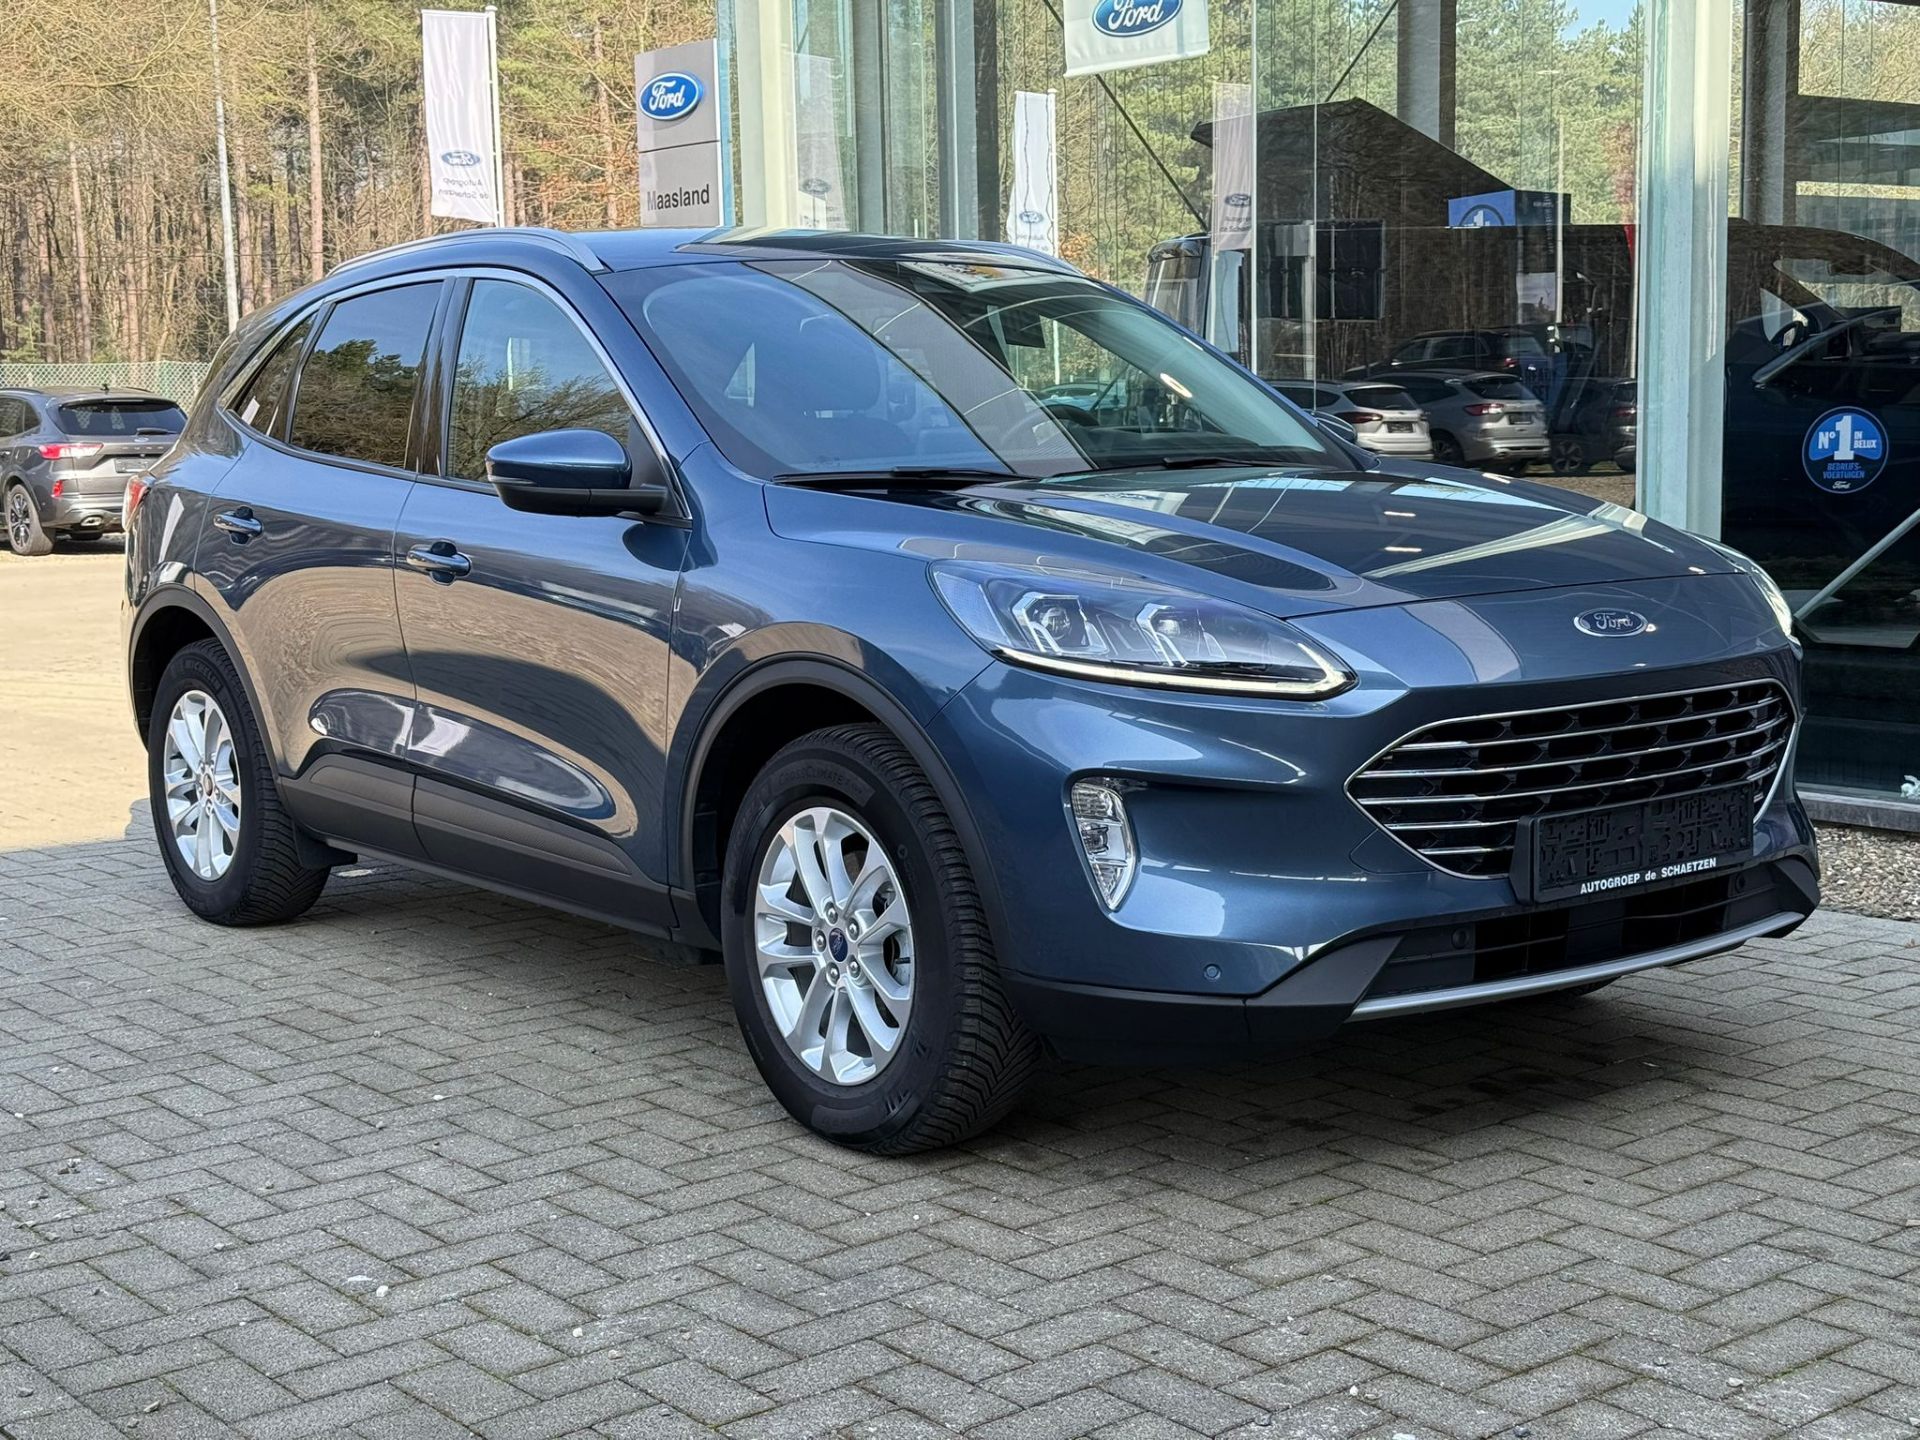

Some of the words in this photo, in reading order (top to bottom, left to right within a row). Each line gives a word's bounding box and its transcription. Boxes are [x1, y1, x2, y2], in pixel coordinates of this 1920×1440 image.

[1108, 0, 1164, 30] Ford
[649, 80, 686, 112] Ford
[647, 184, 710, 211] Maasland
[1834, 415, 1854, 461] 1
[1853, 440, 1877, 449] BELUX
[1854, 431, 1863, 440] IN
[1823, 471, 1865, 479] VOERTUIGEN
[1827, 462, 1862, 471] BEDRIJFS-
[1832, 480, 1851, 489] Ford
[1594, 612, 1634, 630] Ford
[1580, 873, 1641, 895] AUTOGROEP
[1645, 870, 1657, 882] de
[1661, 857, 1717, 879] SCHAETZEN
